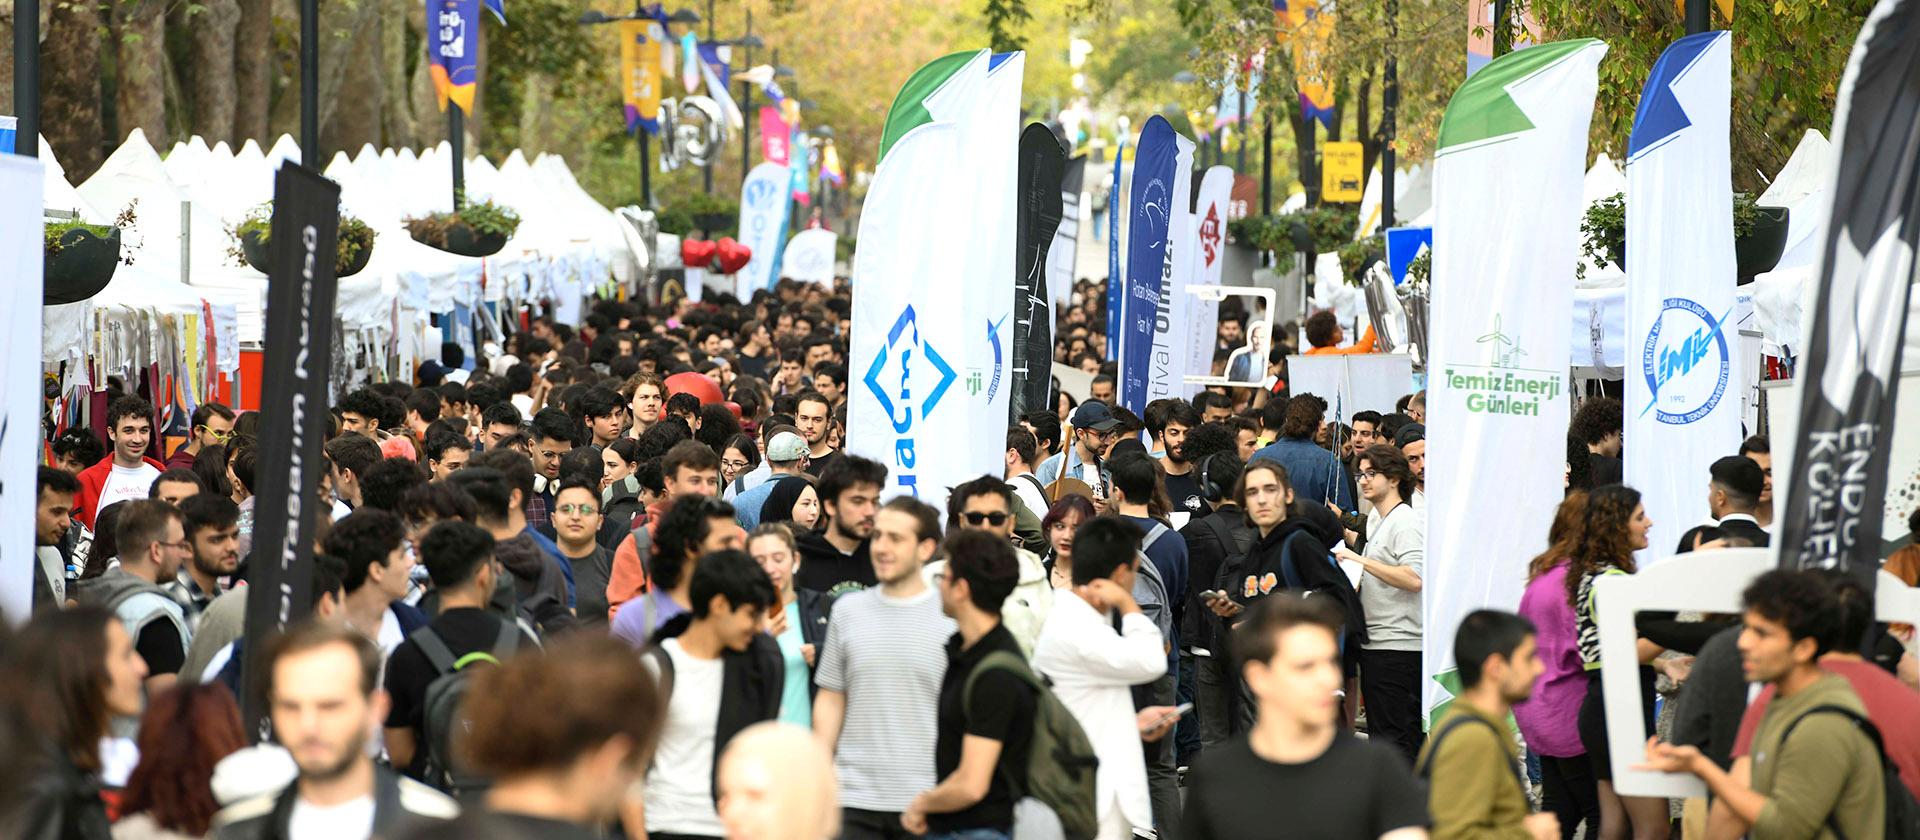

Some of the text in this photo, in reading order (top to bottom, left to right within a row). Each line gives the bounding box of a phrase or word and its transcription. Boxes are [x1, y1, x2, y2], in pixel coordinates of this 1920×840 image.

[1153, 343, 1169, 397] tival
[966, 372, 982, 396] rji
[1445, 369, 1560, 400] Temiz Enerji
[1467, 393, 1538, 416] Günleri
